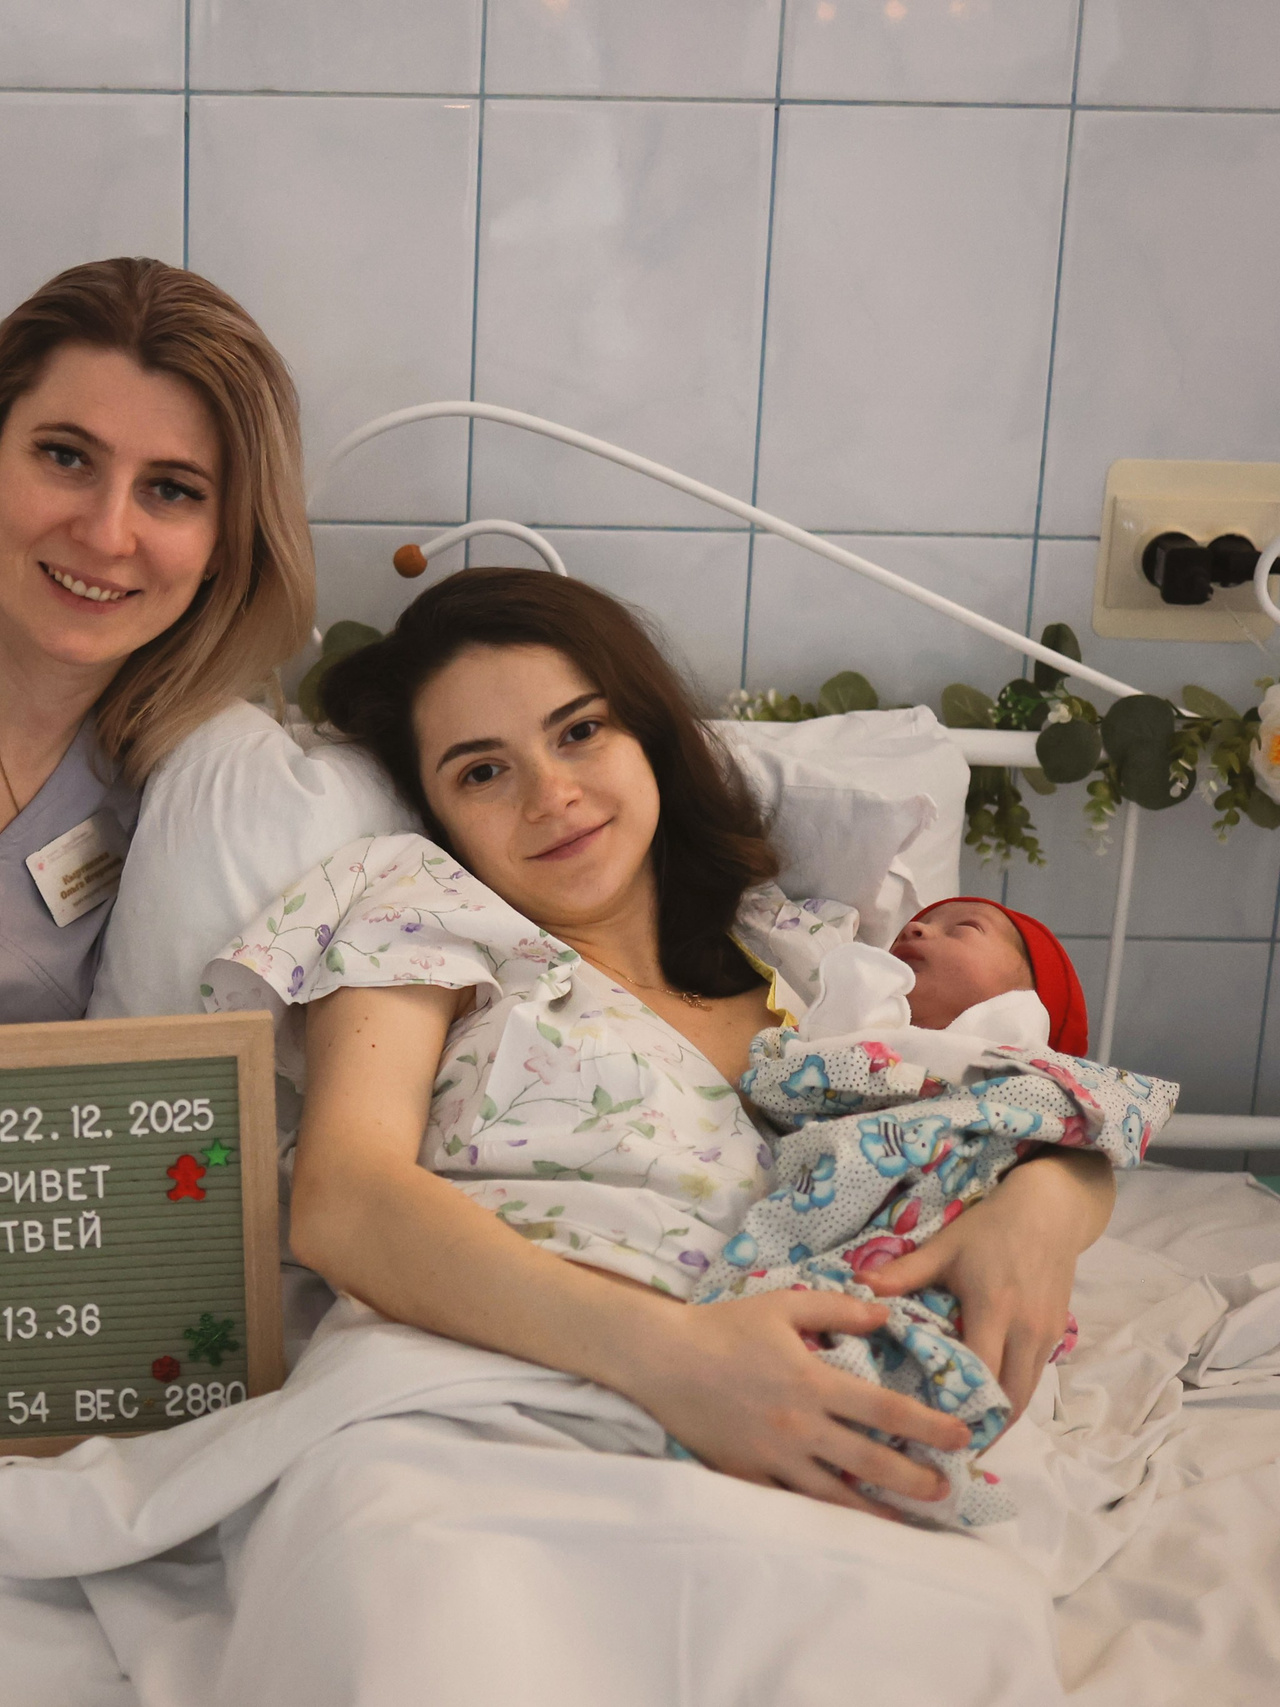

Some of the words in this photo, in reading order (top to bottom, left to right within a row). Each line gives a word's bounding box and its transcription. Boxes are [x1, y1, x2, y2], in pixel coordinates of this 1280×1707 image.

[2, 1303, 101, 1342] 13.36
[8, 1391, 50, 1425] 54
[75, 1387, 139, 1422] ВЕС
[164, 1381, 247, 1418] 2880
